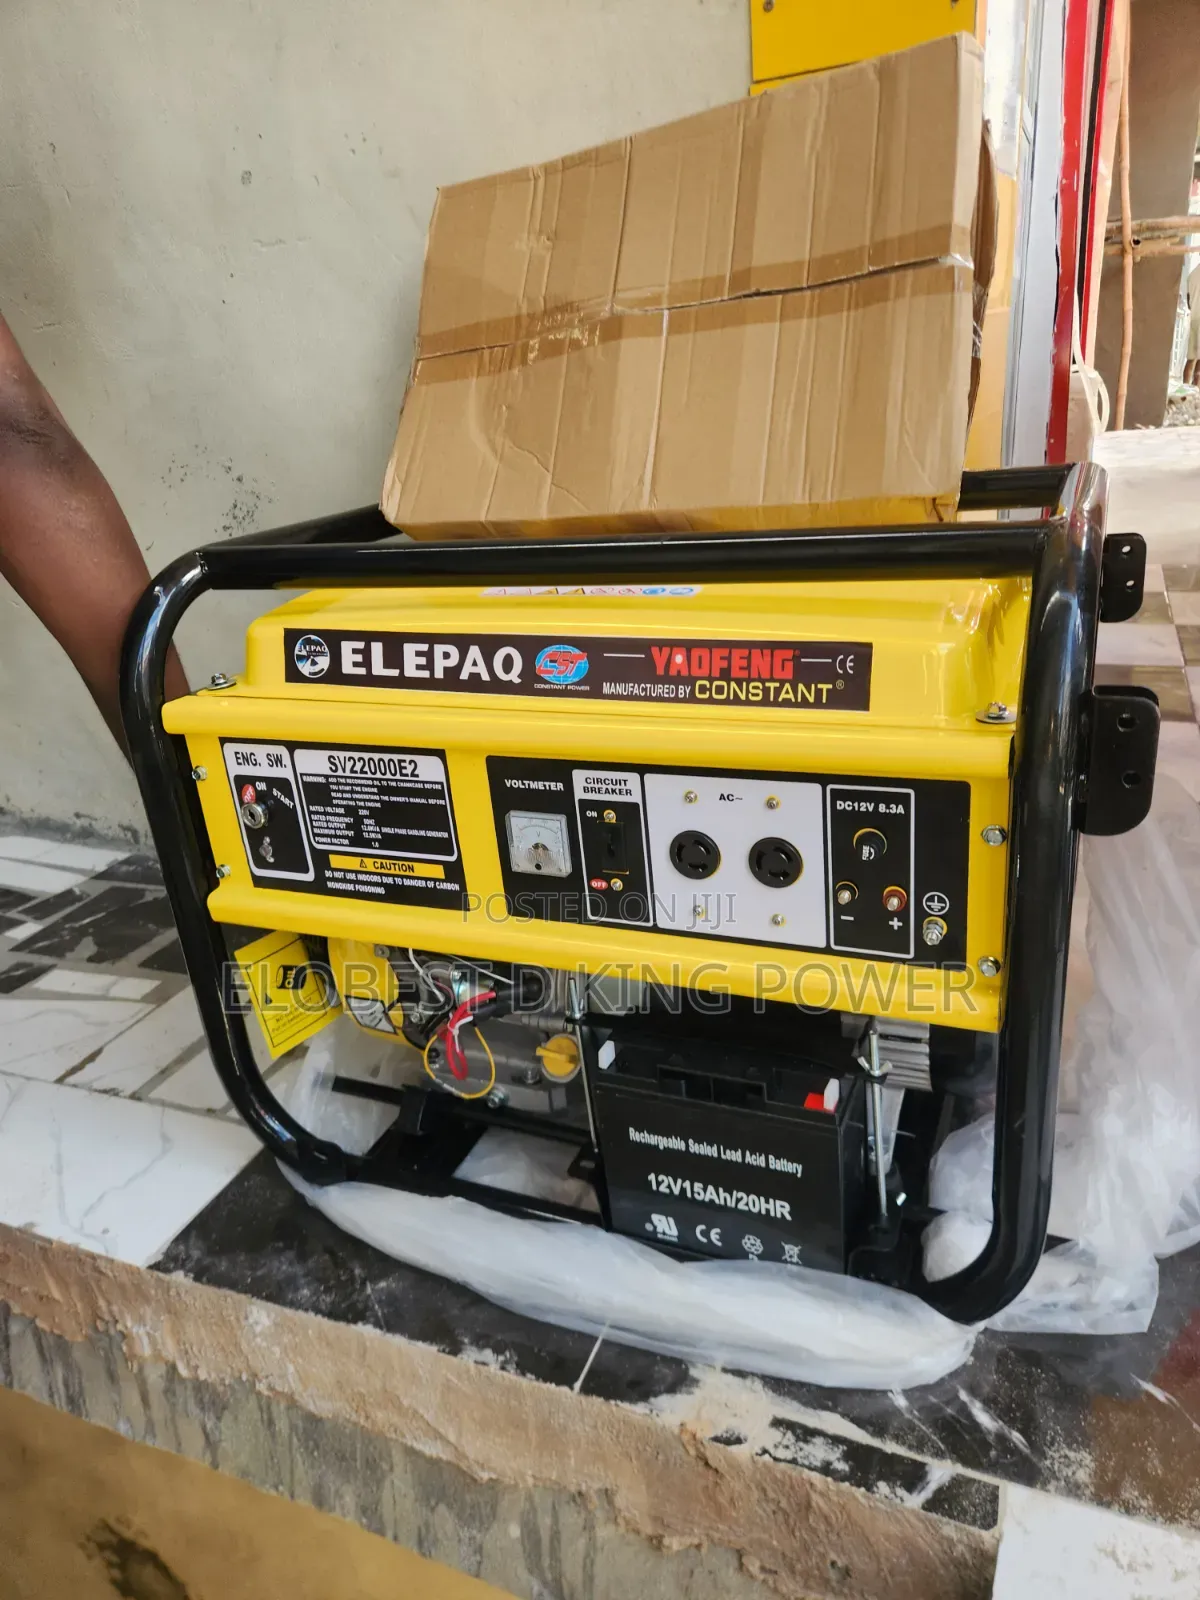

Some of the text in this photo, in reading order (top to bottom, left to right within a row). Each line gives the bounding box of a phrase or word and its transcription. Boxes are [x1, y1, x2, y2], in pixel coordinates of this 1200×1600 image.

[340, 640, 523, 684] ELEPAQ
[535, 652, 588, 676] CST
[651, 646, 795, 680] YAOFENG
[602, 680, 834, 704] MANUFACTURED BY CONSTANT
[234, 751, 287, 769] ENG. SW.
[327, 755, 420, 778] SV22000E2
[255, 781, 267, 791] ON
[505, 778, 565, 792] VOLTMETER
[582, 785, 633, 797] BREAKER
[584, 776, 629, 787] CIRCUIT
[272, 788, 295, 810] START
[836, 800, 905, 815] DC12V 8.3A
[586, 810, 598, 818] ON
[373, 860, 415, 874] CAUTION
[324, 869, 334, 878] DO
[333, 871, 345, 879] NOT
[382, 875, 395, 884] DUE
[394, 877, 403, 885] TO
[403, 878, 427, 888] DANGER
[427, 881, 436, 889] OF
[435, 881, 461, 892] CARBON
[591, 880, 606, 890] OFF
[629, 1127, 802, 1178] Rechargeable Sealed Lead Acid Battery
[648, 1172, 792, 1221] 12V15Ah/20HR
